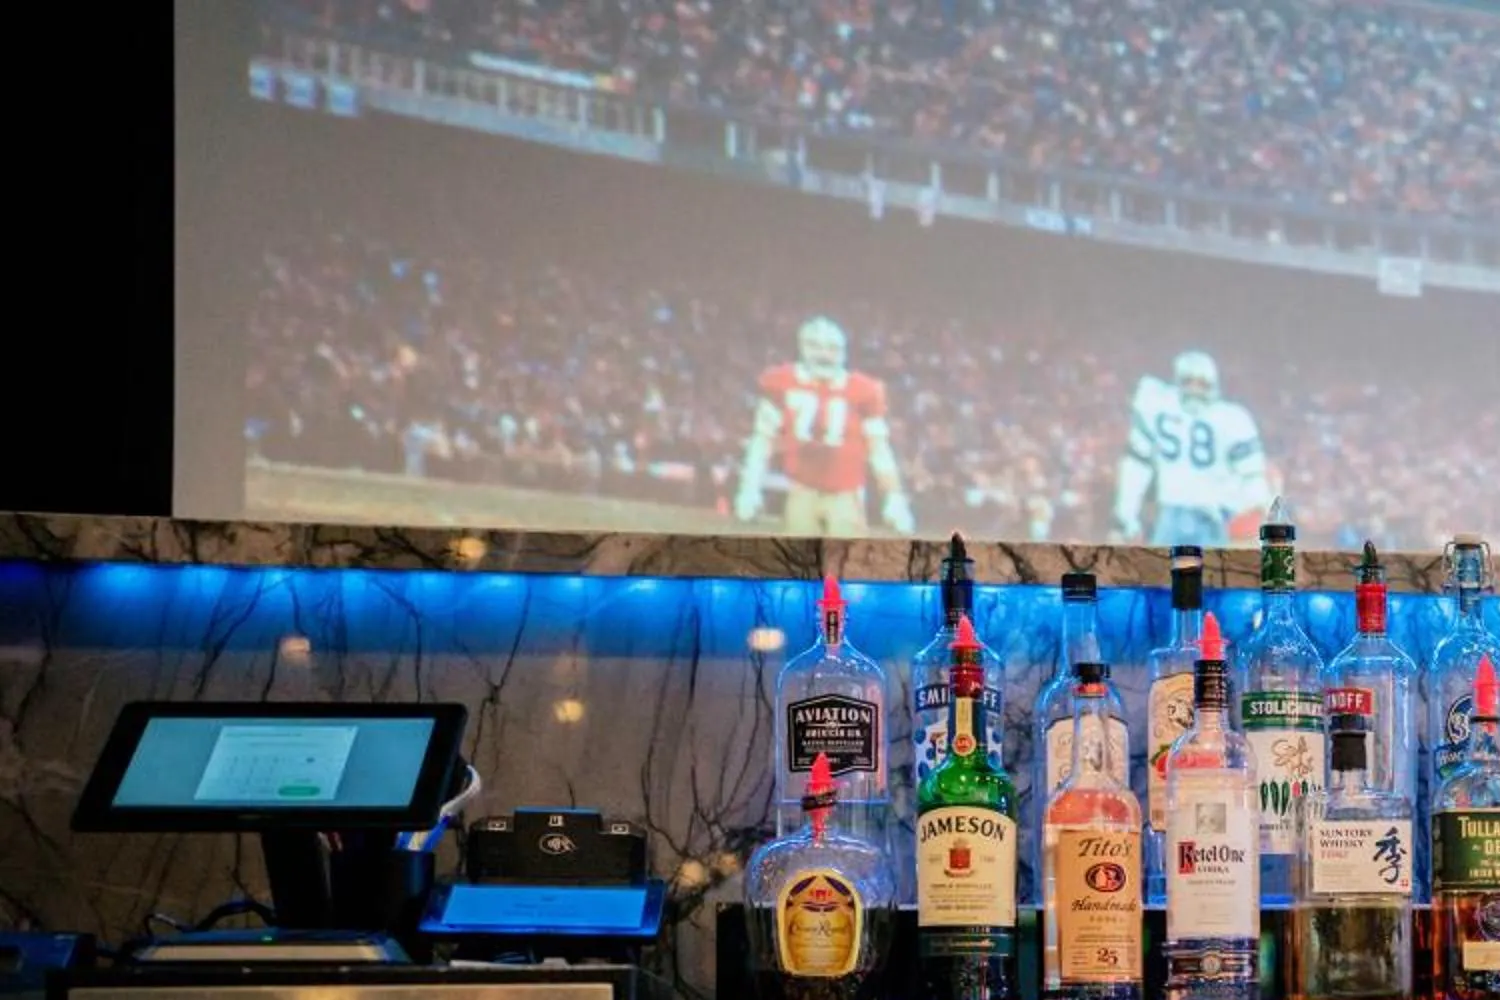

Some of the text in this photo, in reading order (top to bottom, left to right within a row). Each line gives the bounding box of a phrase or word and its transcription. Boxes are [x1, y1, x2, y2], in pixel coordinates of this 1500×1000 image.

[784, 389, 846, 447] 71
[1156, 411, 1217, 469] 58
[917, 686, 998, 708] SMIFF
[795, 707, 871, 723] AVIATION
[920, 815, 1006, 843] JAMESON
[1320, 828, 1373, 838] SUNTORY
[1077, 835, 1133, 858] Tito's
[1320, 839, 1364, 849] WHISKY
[1372, 825, 1408, 885] 季
[1178, 841, 1218, 874] Ketel
